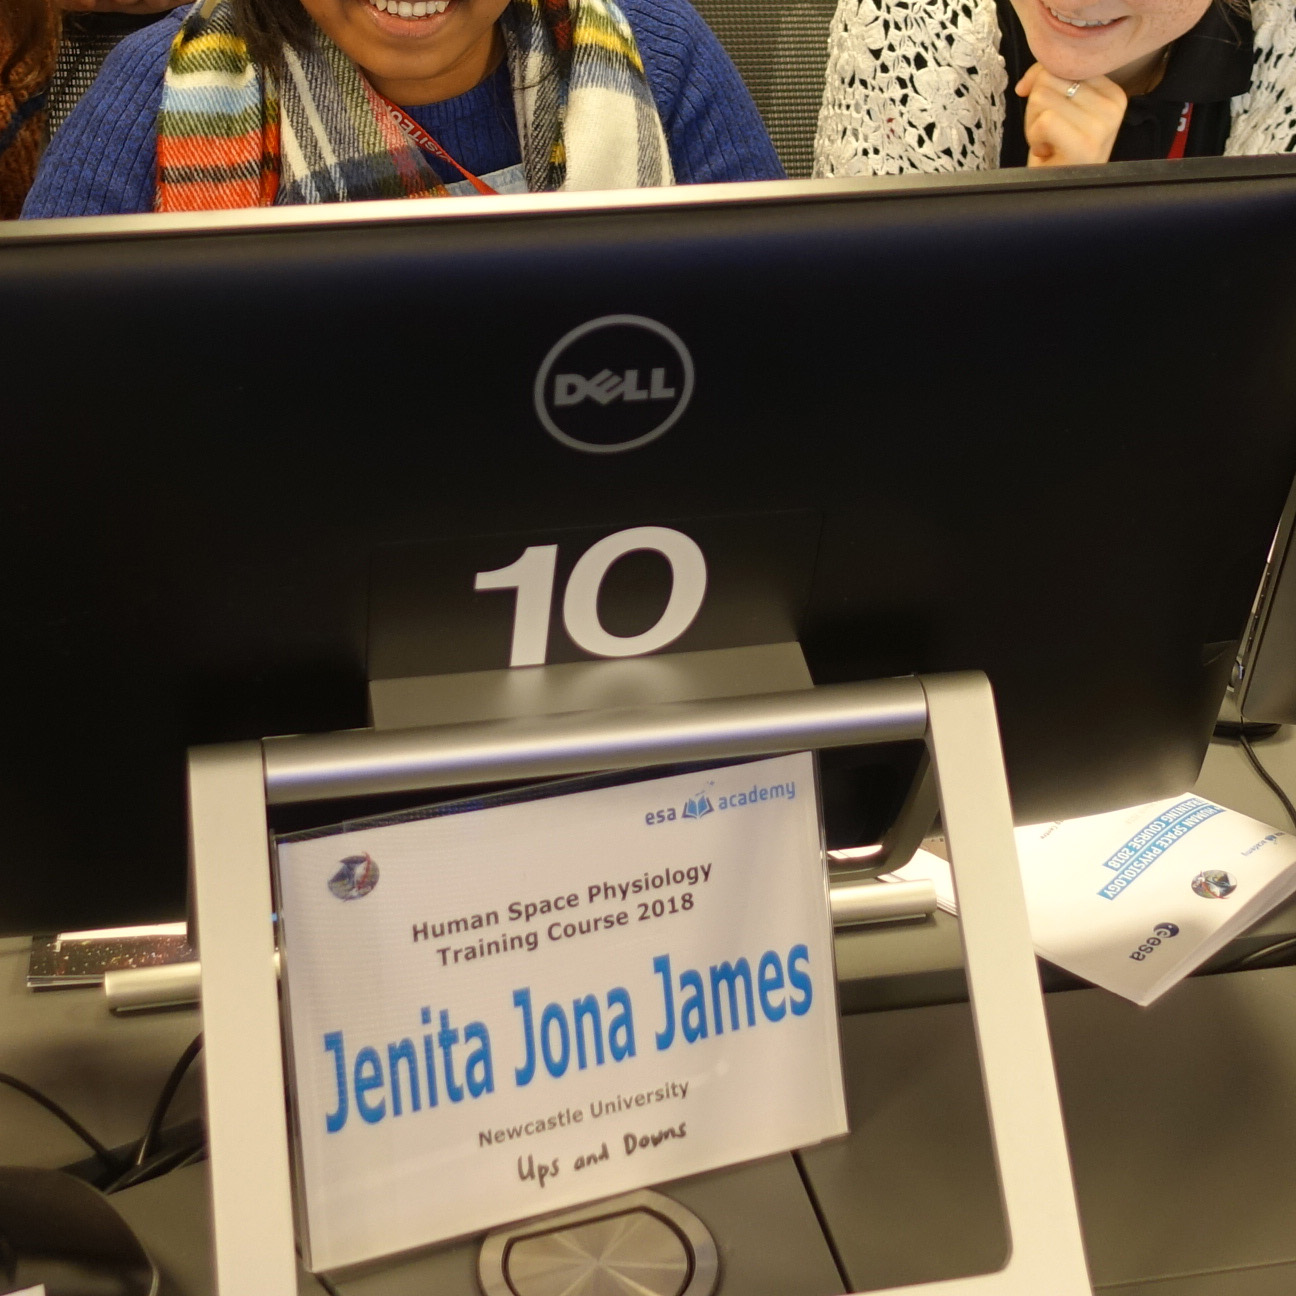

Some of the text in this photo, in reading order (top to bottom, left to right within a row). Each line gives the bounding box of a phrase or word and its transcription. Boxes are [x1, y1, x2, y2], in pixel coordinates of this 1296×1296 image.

[554, 368, 675, 405] DELL
[474, 526, 707, 668] 10
[645, 779, 796, 826] esa academy
[1184, 807, 1217, 828] HUMAN
[1108, 847, 1134, 869] 2018
[1129, 819, 1165, 849] COURSE
[1157, 823, 1187, 849] SPACE
[1104, 846, 1161, 898] PHYSIOLOGY
[412, 860, 713, 943] Human Space Physiology
[436, 892, 695, 968] Training Course 2018
[1129, 937, 1162, 962] esa
[323, 943, 814, 1134] Jenita Jona James
[478, 1080, 690, 1147] Newcastle University
[517, 1121, 688, 1188] Ups and Downs
